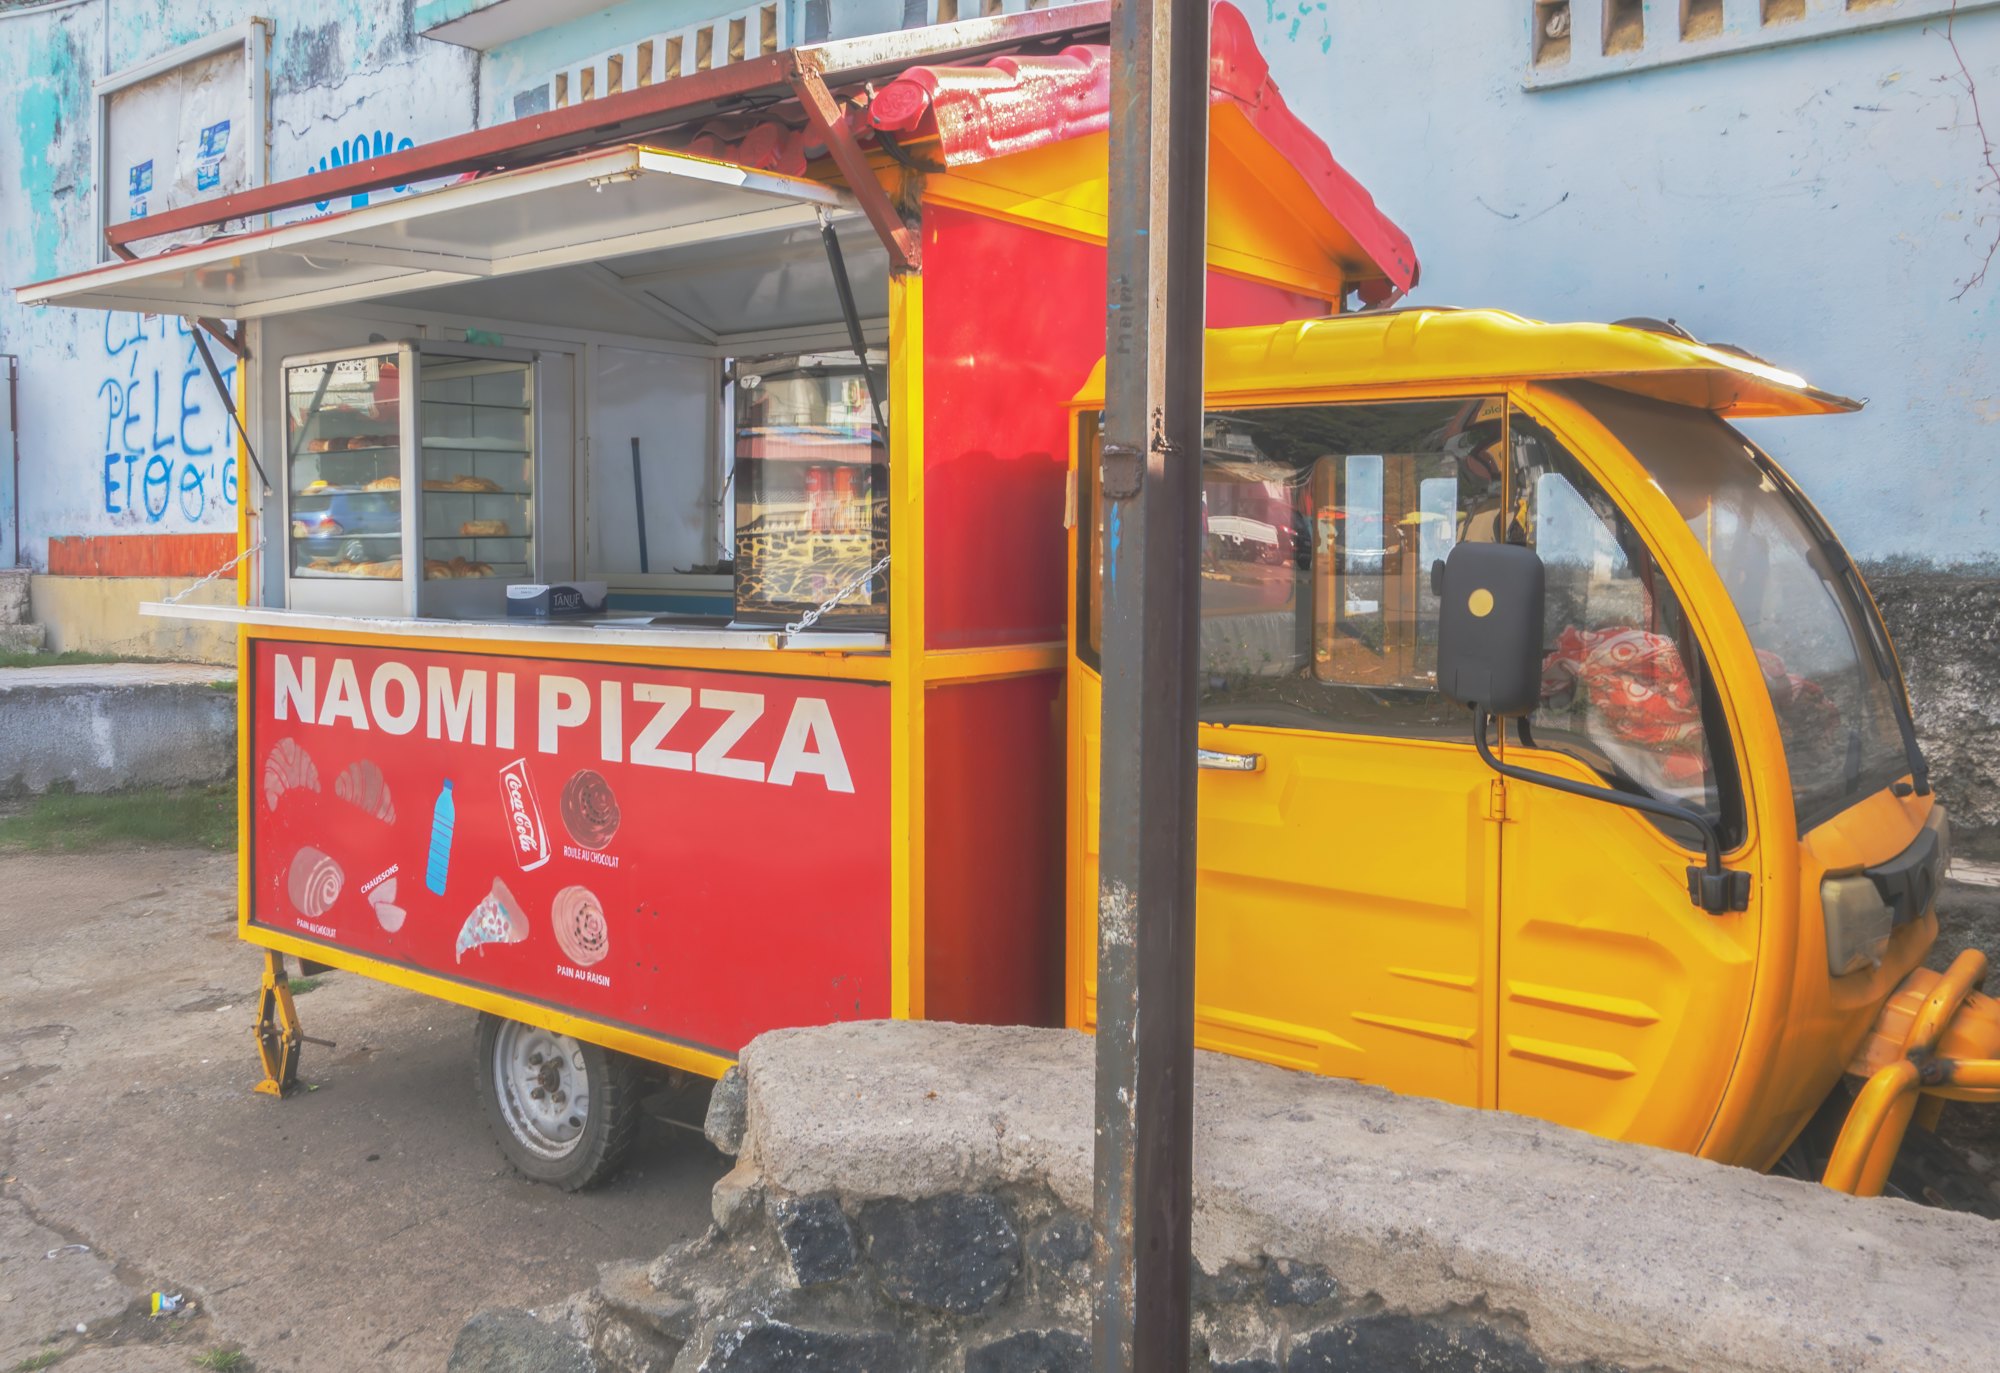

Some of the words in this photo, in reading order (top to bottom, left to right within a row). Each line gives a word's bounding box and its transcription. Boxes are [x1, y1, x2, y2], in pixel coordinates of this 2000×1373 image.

[274, 654, 516, 750] NAOMI
[538, 674, 855, 794] PIZZA
[581, 850, 590, 861] AU
[590, 851, 619, 868] CHOCOLAT
[360, 863, 399, 894] CHAUSSONS
[296, 917, 309, 930] PAIN
[309, 922, 316, 933] AU
[316, 924, 337, 938] CHOCOLAT
[557, 965, 574, 978] PAIN
[574, 969, 586, 981] AU
[586, 971, 610, 987] RAISIN
